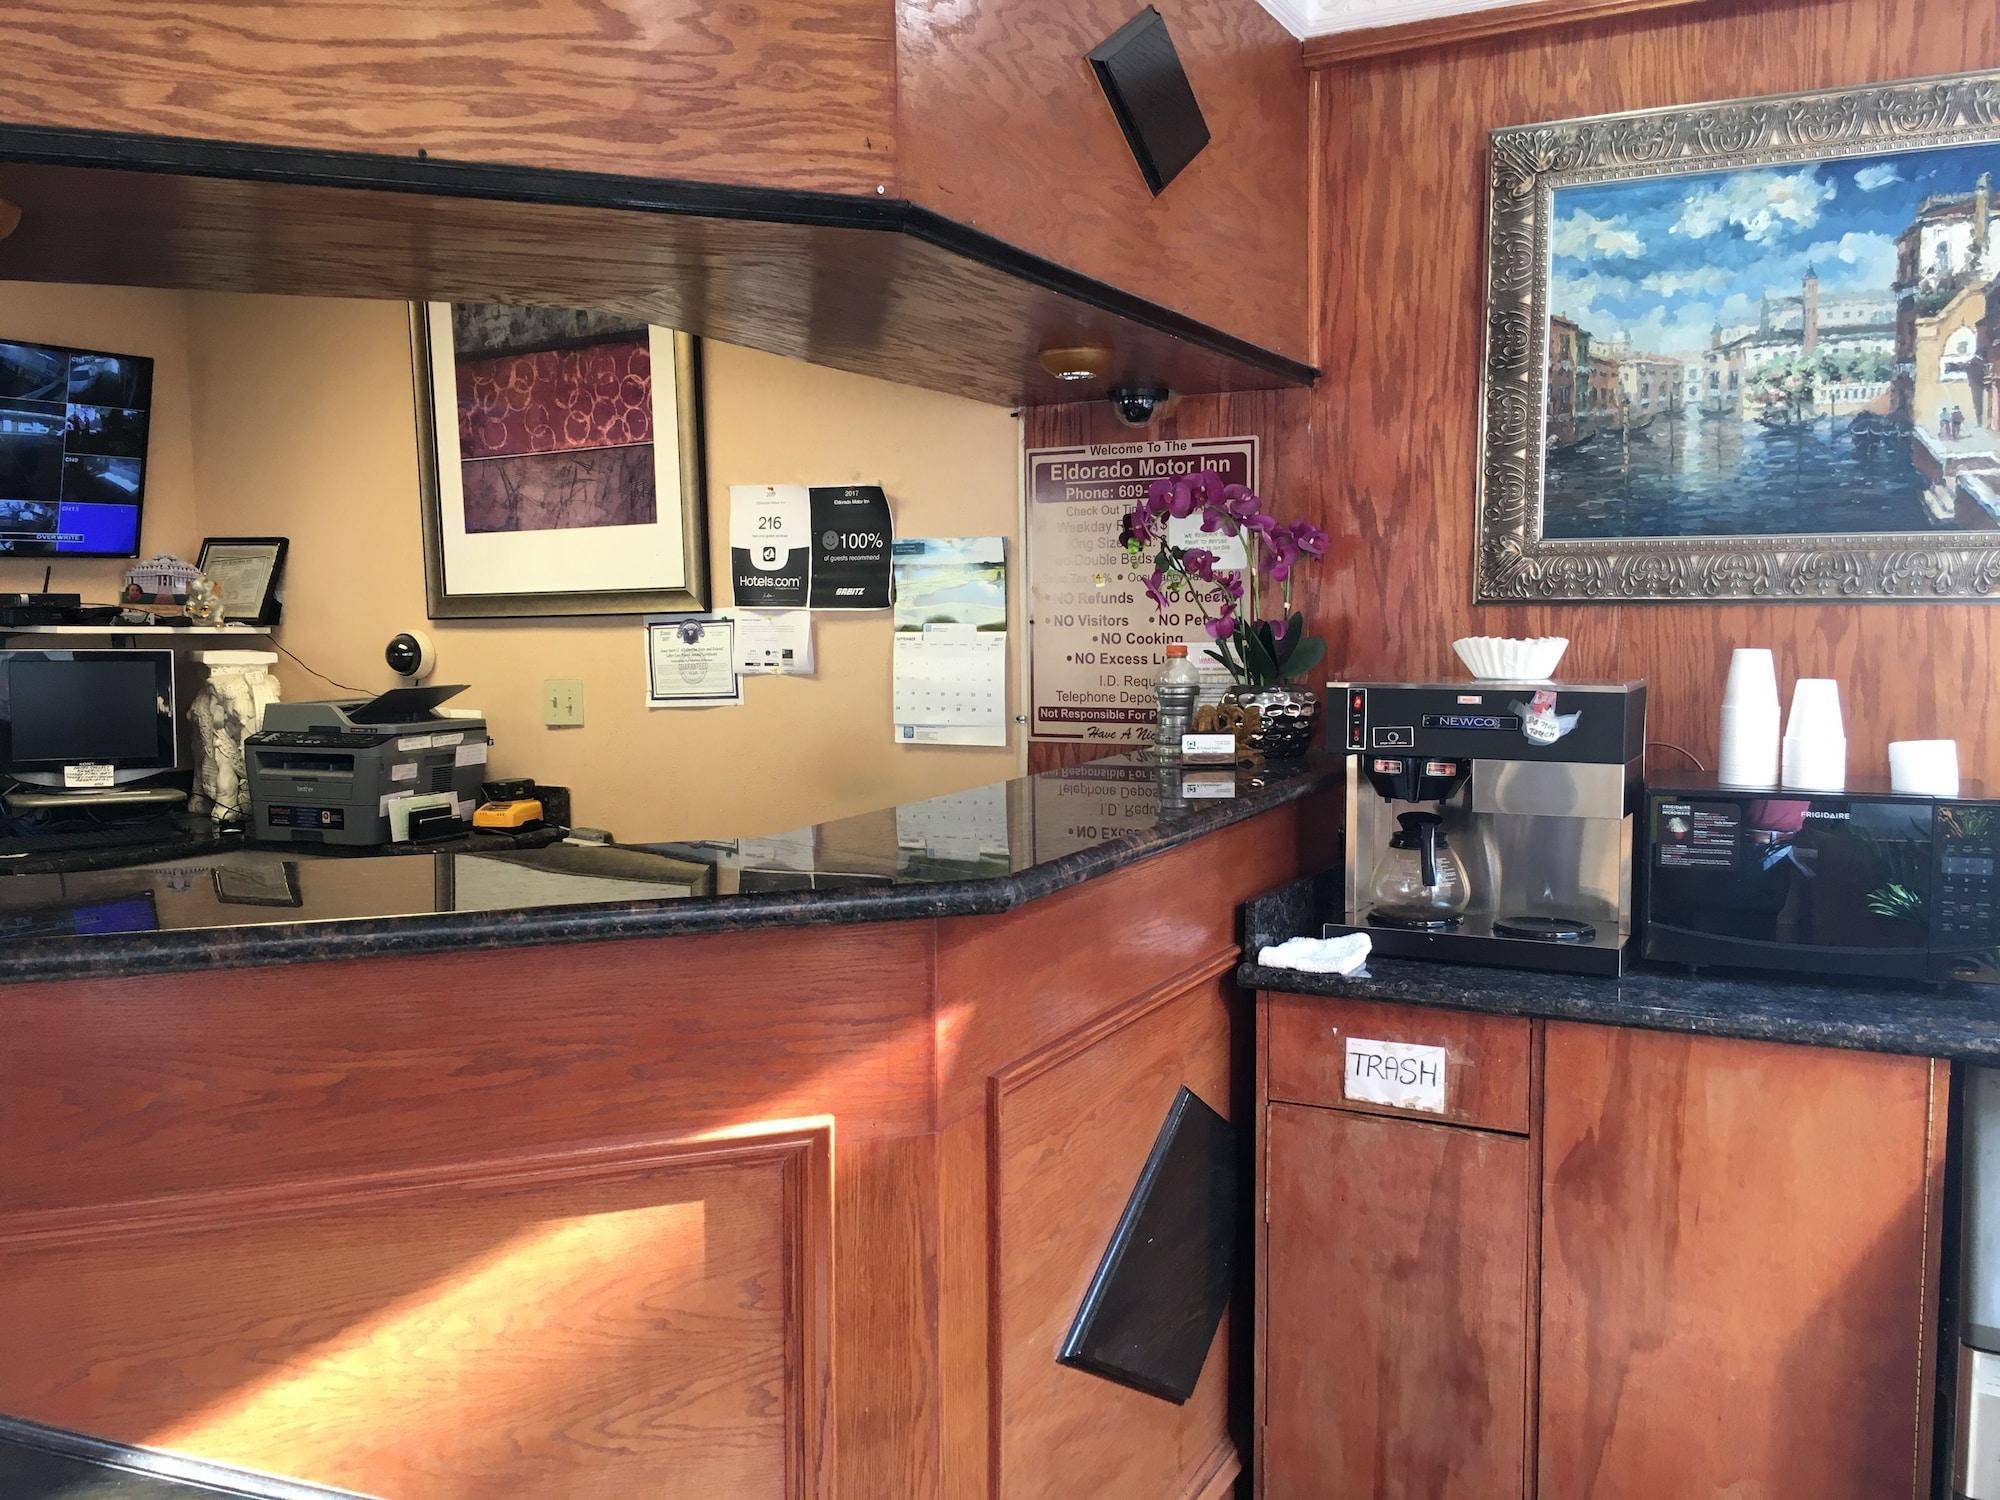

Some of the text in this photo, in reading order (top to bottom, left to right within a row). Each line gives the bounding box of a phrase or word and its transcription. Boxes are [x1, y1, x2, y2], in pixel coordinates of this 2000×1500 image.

[1090, 441, 1187, 456] Welcome To The
[1051, 456, 1231, 480] Eldorado Motor Inn
[1065, 487, 1114, 500] Phone:
[1066, 505, 1098, 517] Check
[1101, 504, 1120, 515] Out
[758, 516, 782, 530] 216
[1057, 519, 1112, 533] Weekday
[840, 533, 884, 549] 100%
[1097, 537, 1120, 549] Size
[1074, 554, 1117, 566] Double
[740, 576, 800, 588] Hotels.com
[1078, 592, 1134, 605] Refunds
[1054, 614, 1129, 627] NO Visitors
[1159, 613, 1211, 626] NO Pet
[1101, 632, 1183, 645] NO Cooking
[1075, 653, 1095, 665] NO
[1100, 653, 1148, 665] Excess
[1100, 675, 1120, 687] I.D.
[1056, 690, 1116, 704] Telephone
[1040, 708, 1058, 719] Not
[1060, 709, 1125, 721] Responsible
[1128, 709, 1147, 720] For
[1439, 717, 1495, 727] NEWCO
[1087, 726, 1117, 740] Have
[1121, 727, 1132, 739] A
[1800, 811, 1850, 820] FRIGIDAIRE
[1348, 1052, 1437, 1087] TRASH
